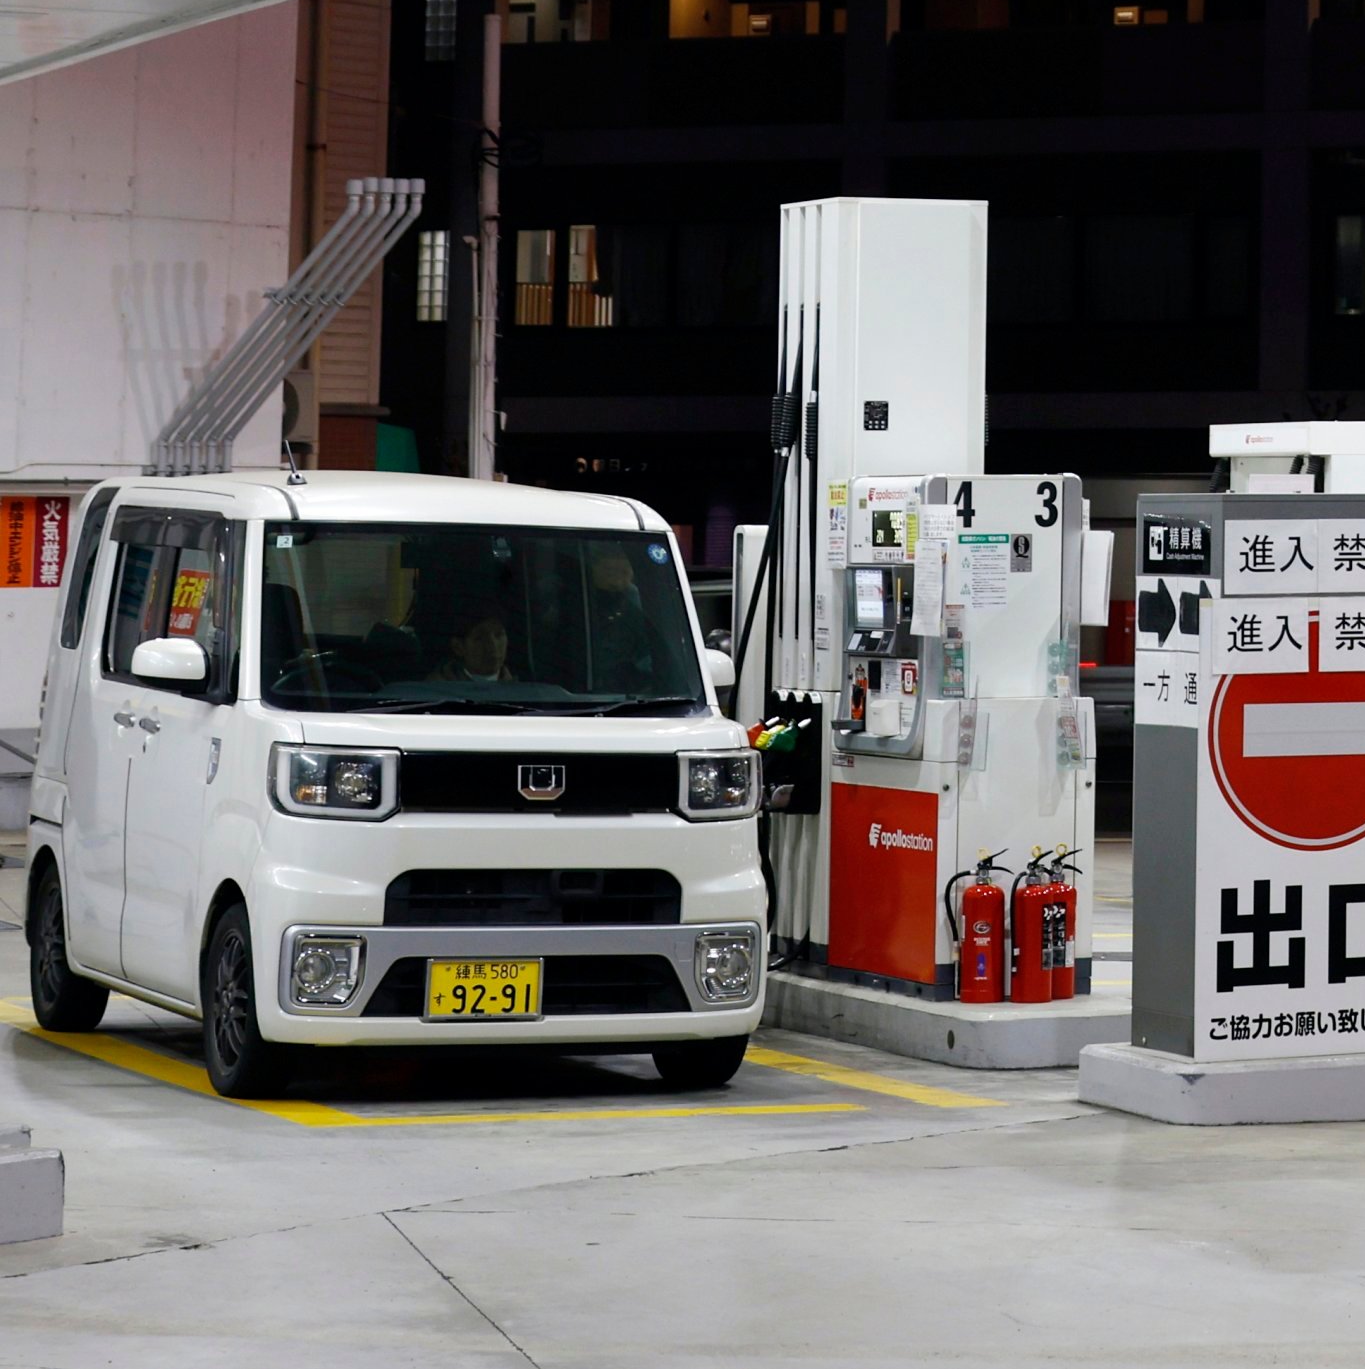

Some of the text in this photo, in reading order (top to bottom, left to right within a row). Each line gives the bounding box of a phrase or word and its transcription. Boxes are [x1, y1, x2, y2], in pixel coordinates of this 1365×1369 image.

[954, 481, 975, 528] 4
[1034, 481, 1058, 528] 3
[40, 500, 62, 585] 火気厳禁
[1169, 526, 1202, 550] 精算機
[881, 829, 934, 852] apollostation
[455, 964, 518, 979] 練馬 580
[452, 983, 530, 1013] 92-91
